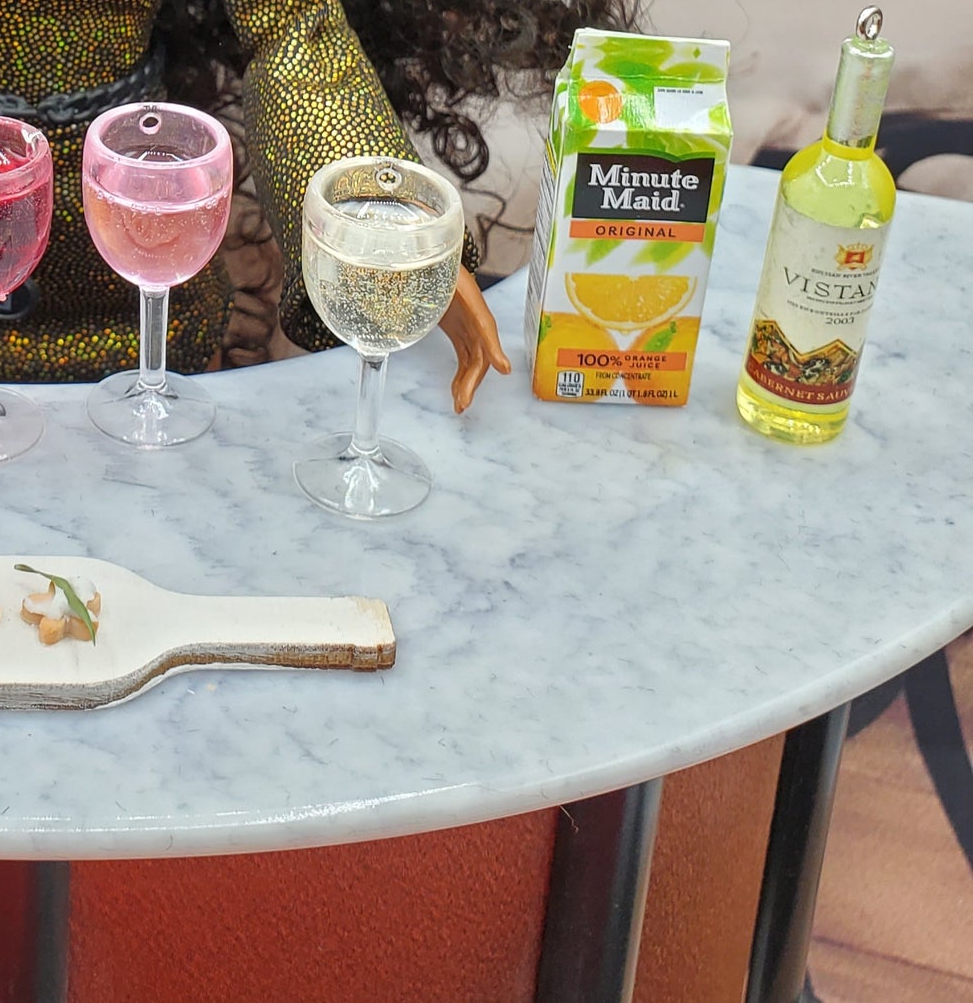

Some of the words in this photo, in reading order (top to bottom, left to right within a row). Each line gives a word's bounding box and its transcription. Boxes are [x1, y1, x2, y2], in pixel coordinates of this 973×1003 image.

[588, 163, 700, 190] Minute
[600, 187, 680, 212] Maid
[595, 225, 676, 238] ORIGINAL
[577, 353, 622, 367] 100%
[624, 354, 667, 362] ORANGE
[562, 372, 580, 383] 110
